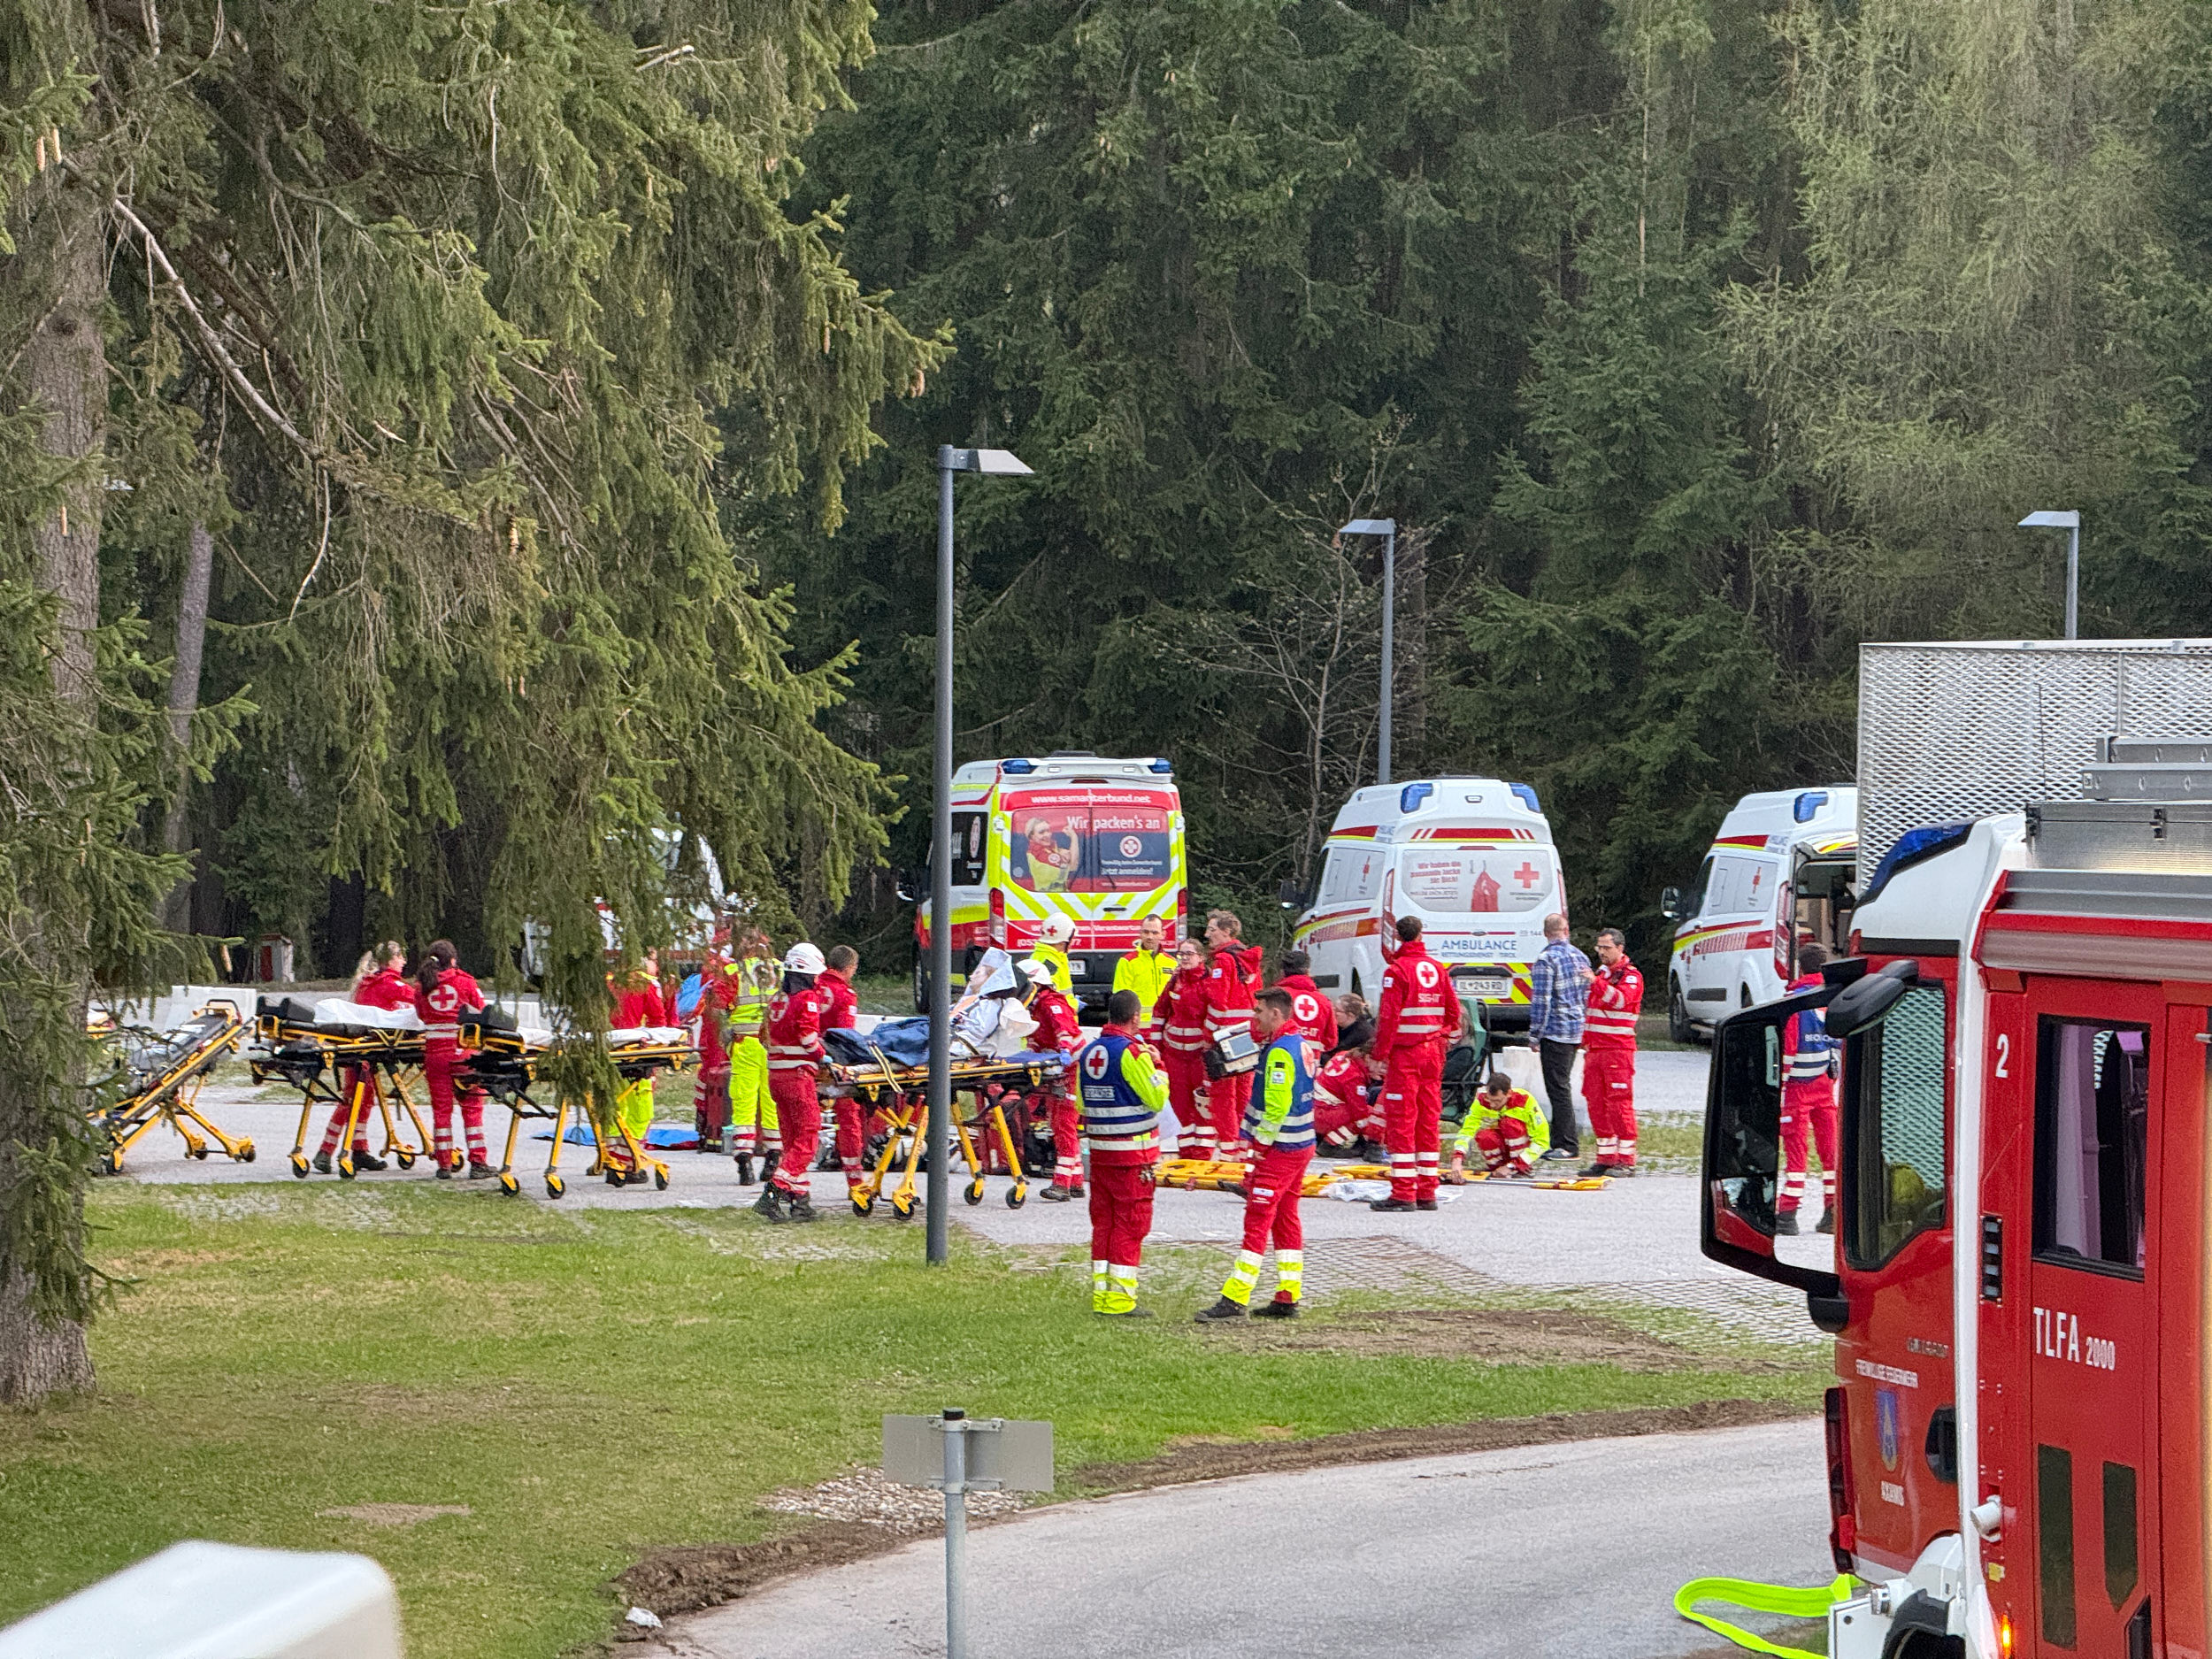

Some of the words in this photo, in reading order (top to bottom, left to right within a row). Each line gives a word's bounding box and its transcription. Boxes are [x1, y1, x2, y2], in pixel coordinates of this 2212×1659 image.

[1067, 816, 1089, 829] Wir
[1093, 816, 1143, 832] packen's
[1145, 818, 1160, 829] an
[1441, 940, 1517, 950] AMBULANCE
[1995, 1033, 2009, 1079] 2
[2033, 1306, 2080, 1363] TLFA
[2085, 1336, 2116, 1371] 2000
